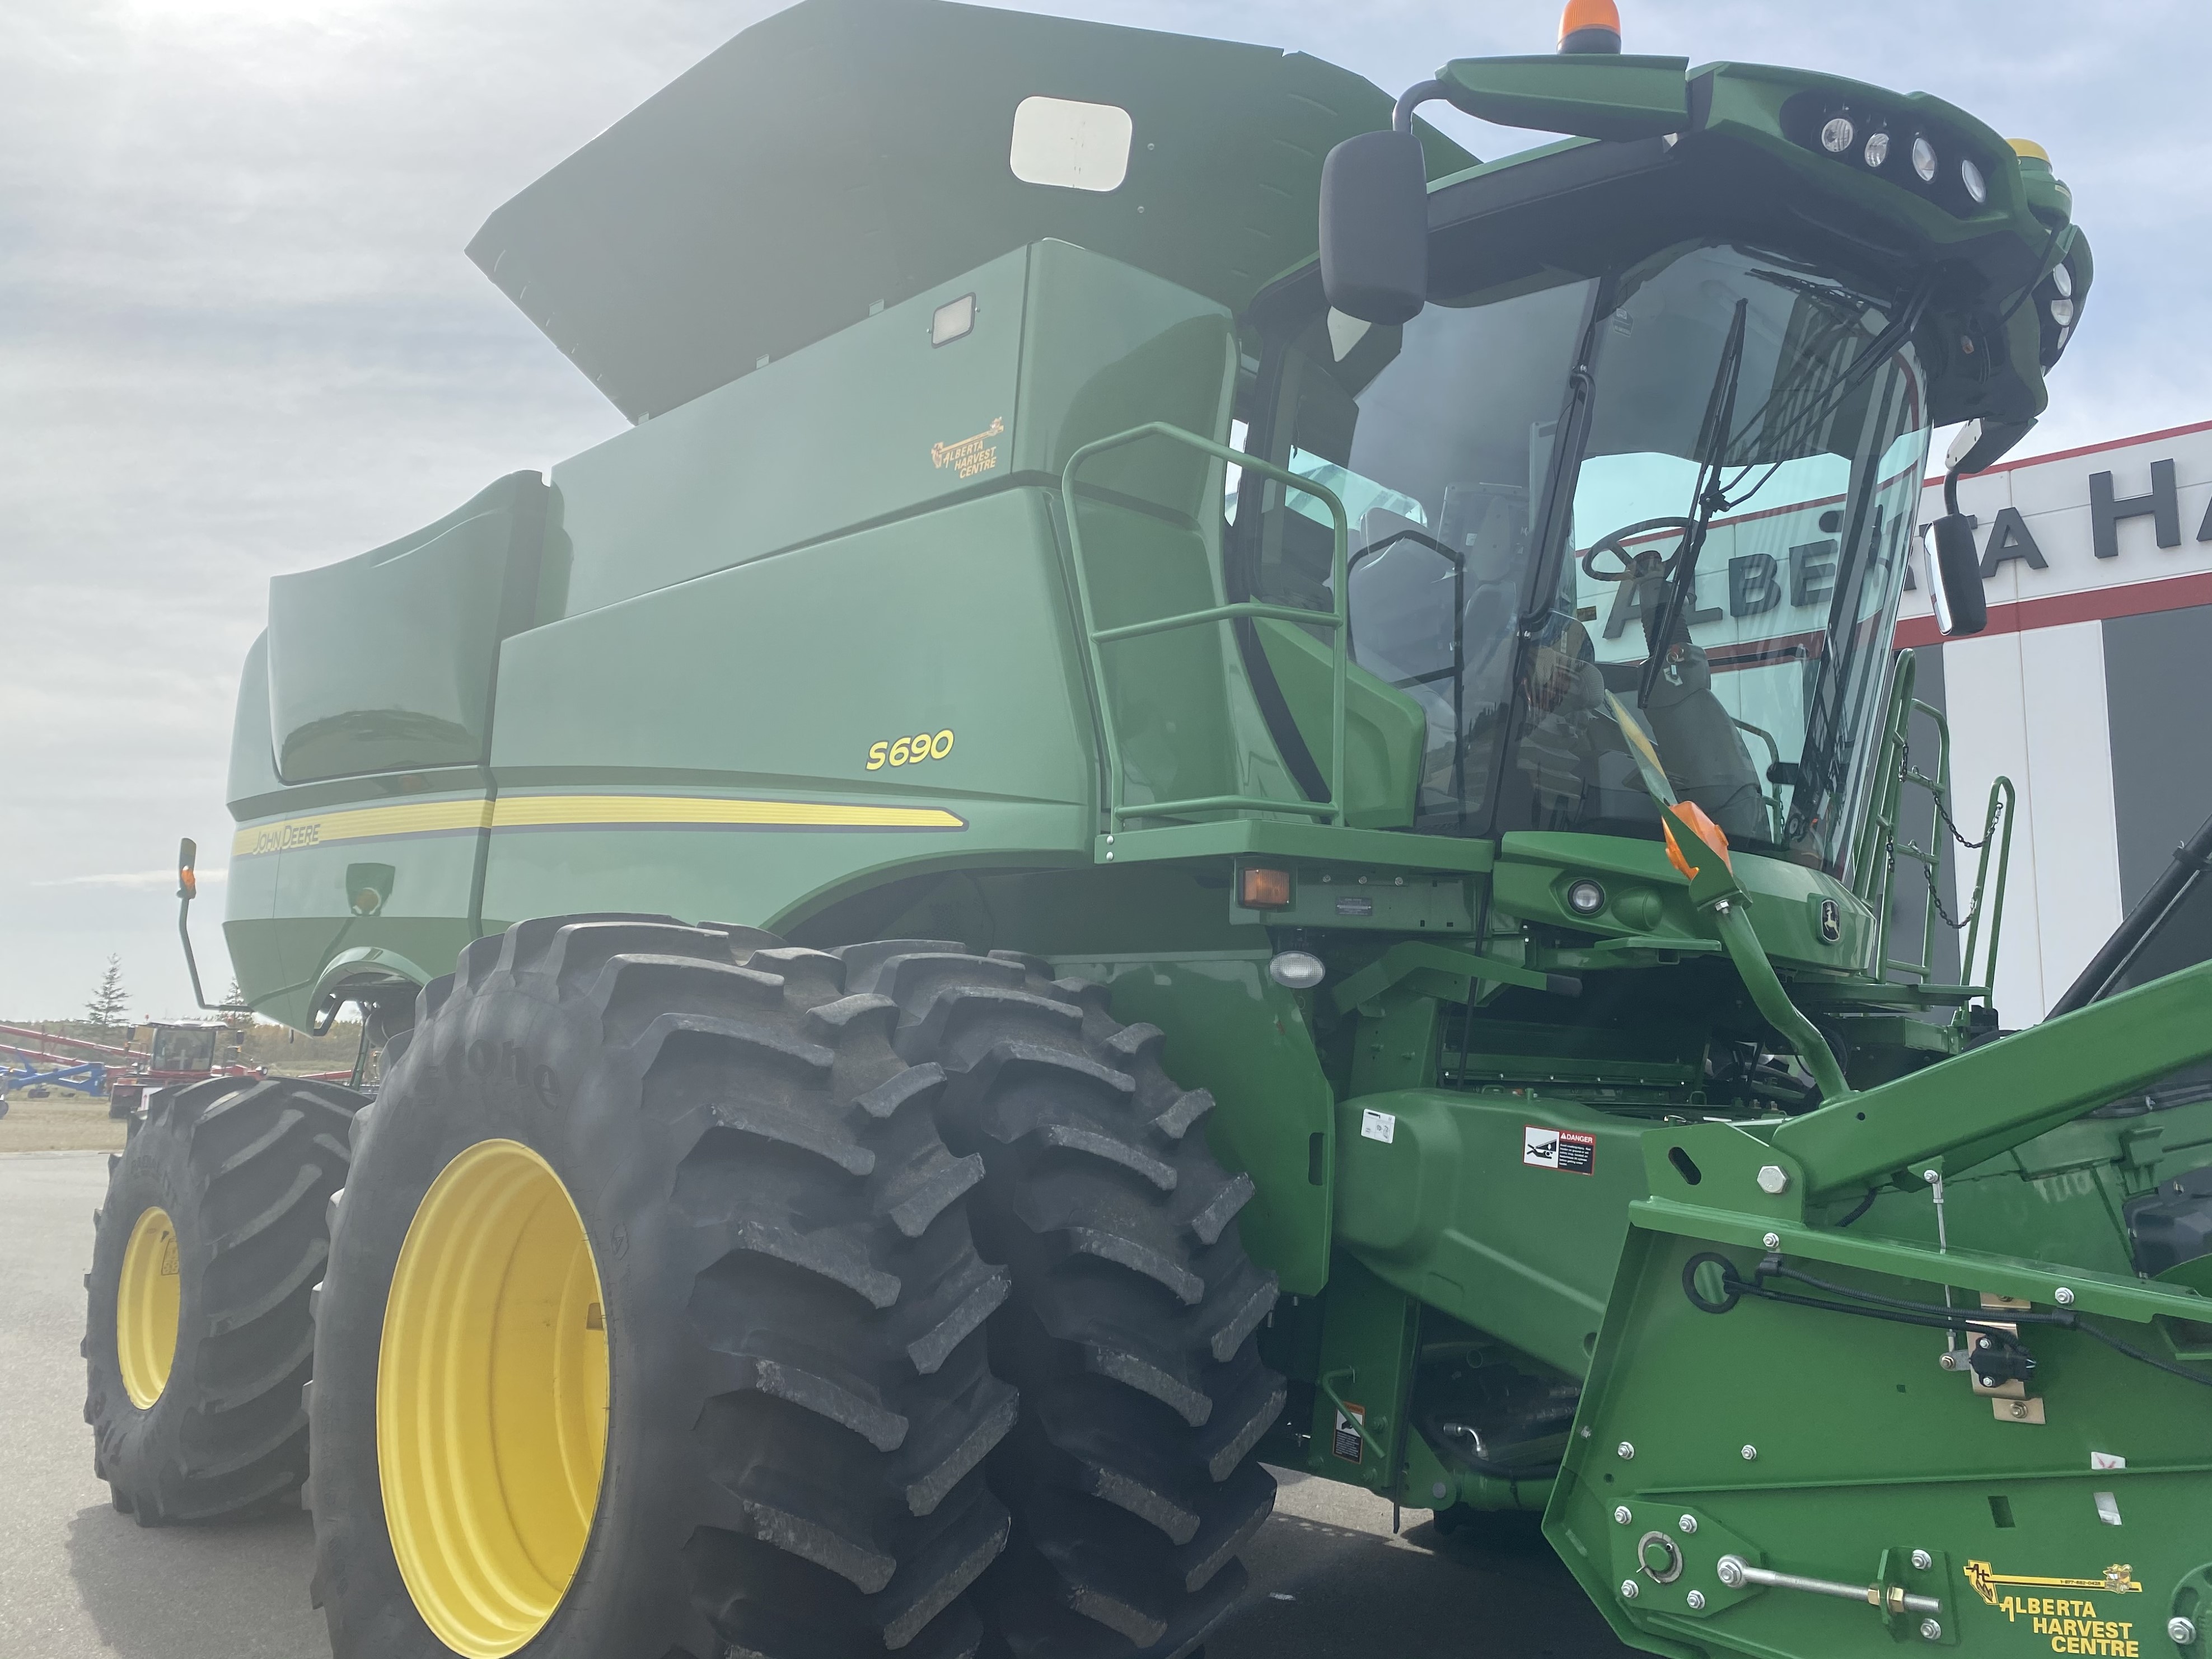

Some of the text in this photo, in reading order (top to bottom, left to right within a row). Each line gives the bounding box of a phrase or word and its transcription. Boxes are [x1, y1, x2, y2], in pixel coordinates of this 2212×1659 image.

[943, 440, 984, 468] ALBERTA
[954, 447, 997, 471] HARVEST
[960, 458, 996, 479] CENTRE
[2089, 458, 2212, 559] H
[866, 729, 955, 771] S690
[252, 823, 321, 854] JOHN DEERE
[1566, 1133, 1593, 1144] DANGER
[1999, 1596, 2096, 1622] ALBERTA
[2033, 1617, 2133, 1639] HARVEST
[2051, 1637, 2139, 1658] CENTRE
